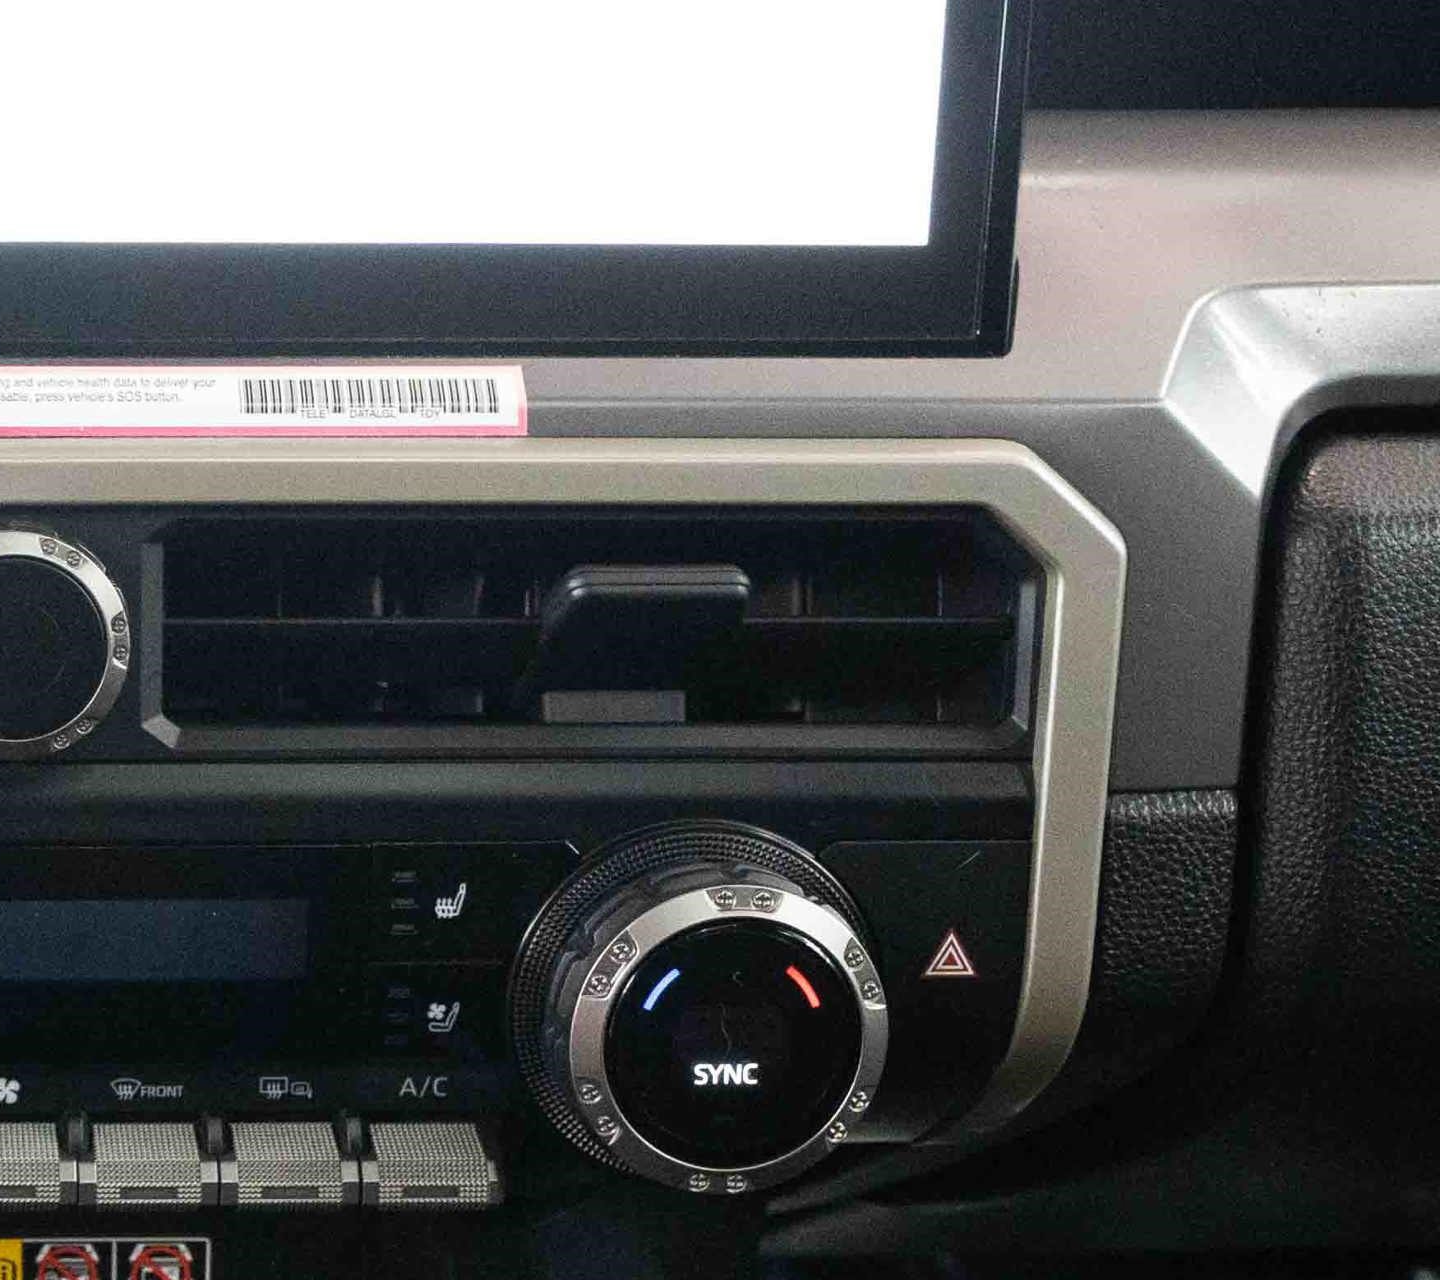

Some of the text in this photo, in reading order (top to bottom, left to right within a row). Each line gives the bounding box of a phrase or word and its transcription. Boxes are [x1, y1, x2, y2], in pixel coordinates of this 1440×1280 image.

[14, 378, 34, 388] and
[77, 378, 110, 388] health
[113, 378, 137, 388] data
[140, 378, 150, 388] to
[35, 393, 65, 404] press
[116, 392, 142, 403] SOS
[693, 1062, 759, 1086] SYNC
[140, 1084, 184, 1100] FRONT
[399, 1076, 449, 1098] A/C
